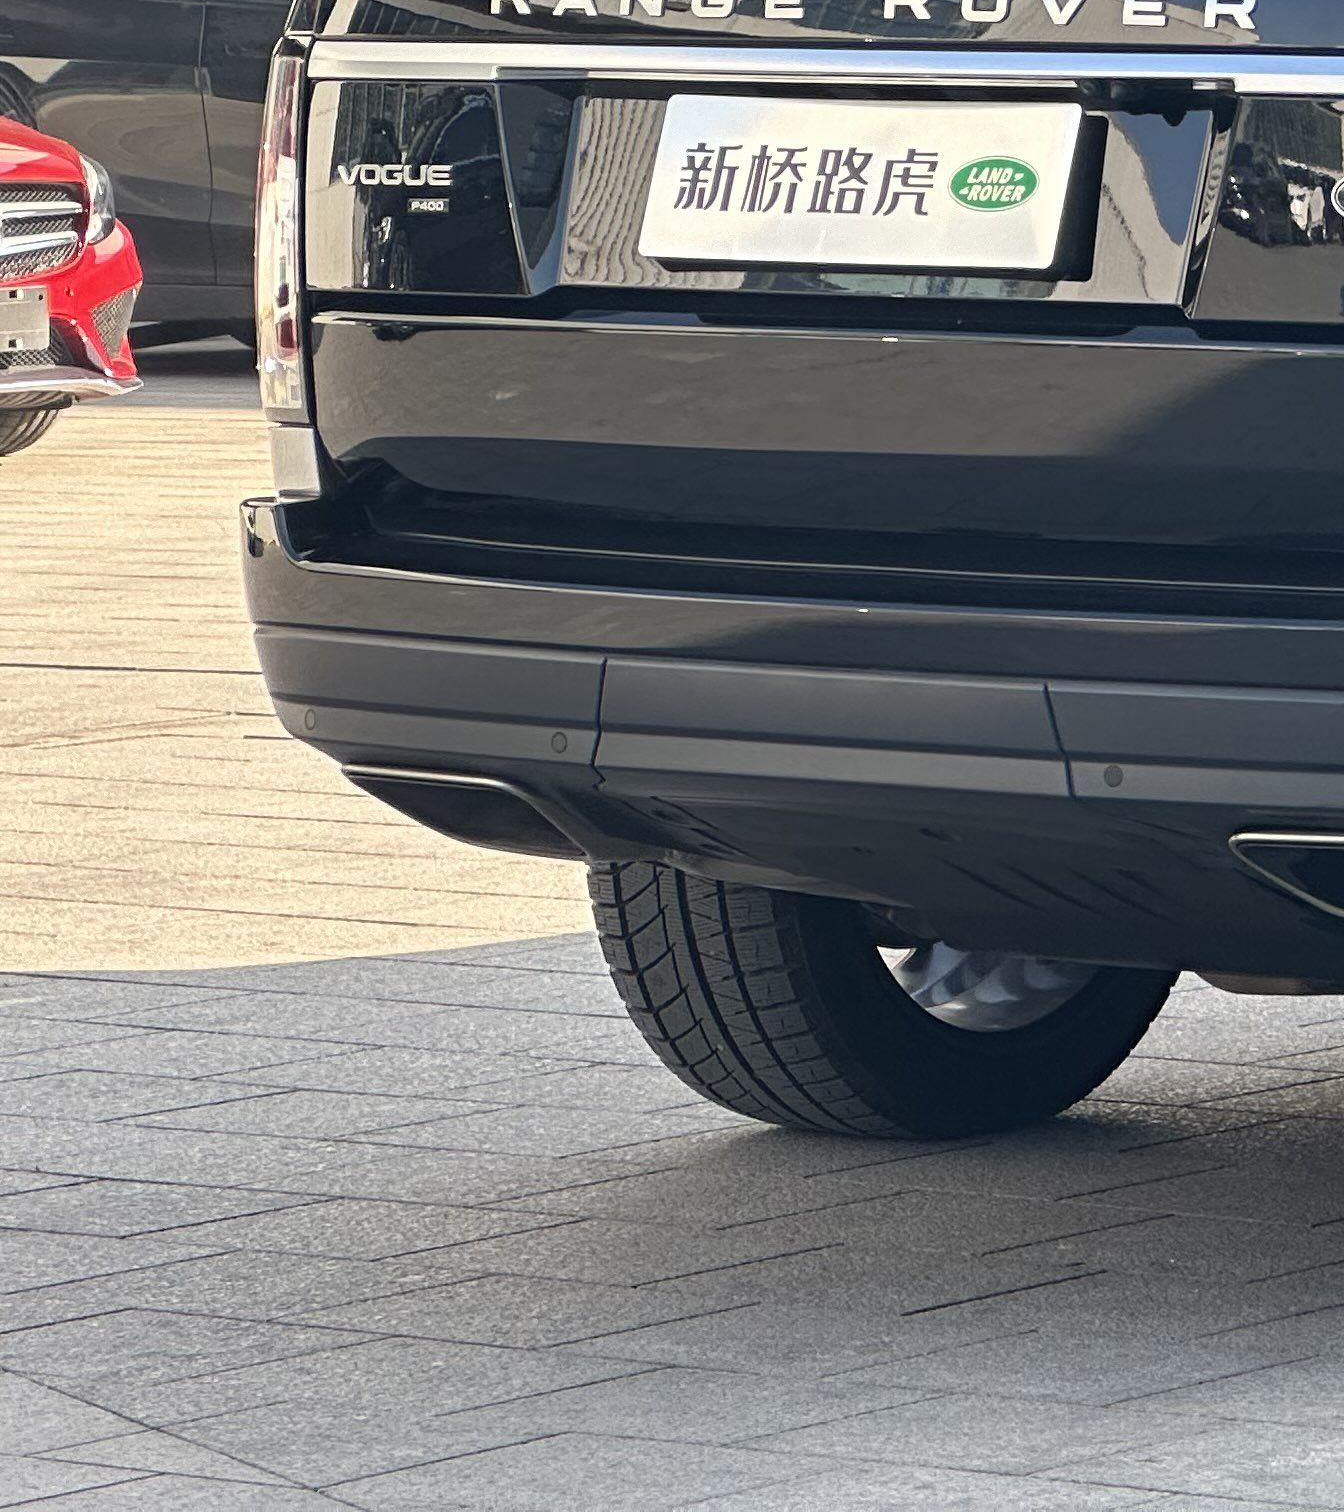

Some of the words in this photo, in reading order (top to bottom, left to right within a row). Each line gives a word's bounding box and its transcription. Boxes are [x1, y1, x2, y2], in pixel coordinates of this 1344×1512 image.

[337, 164, 454, 186] VOGUE
[673, 142, 939, 216] 新桥路虎
[967, 167, 1014, 183] LAND
[967, 185, 1025, 201] ROVER
[411, 200, 444, 211] P400
